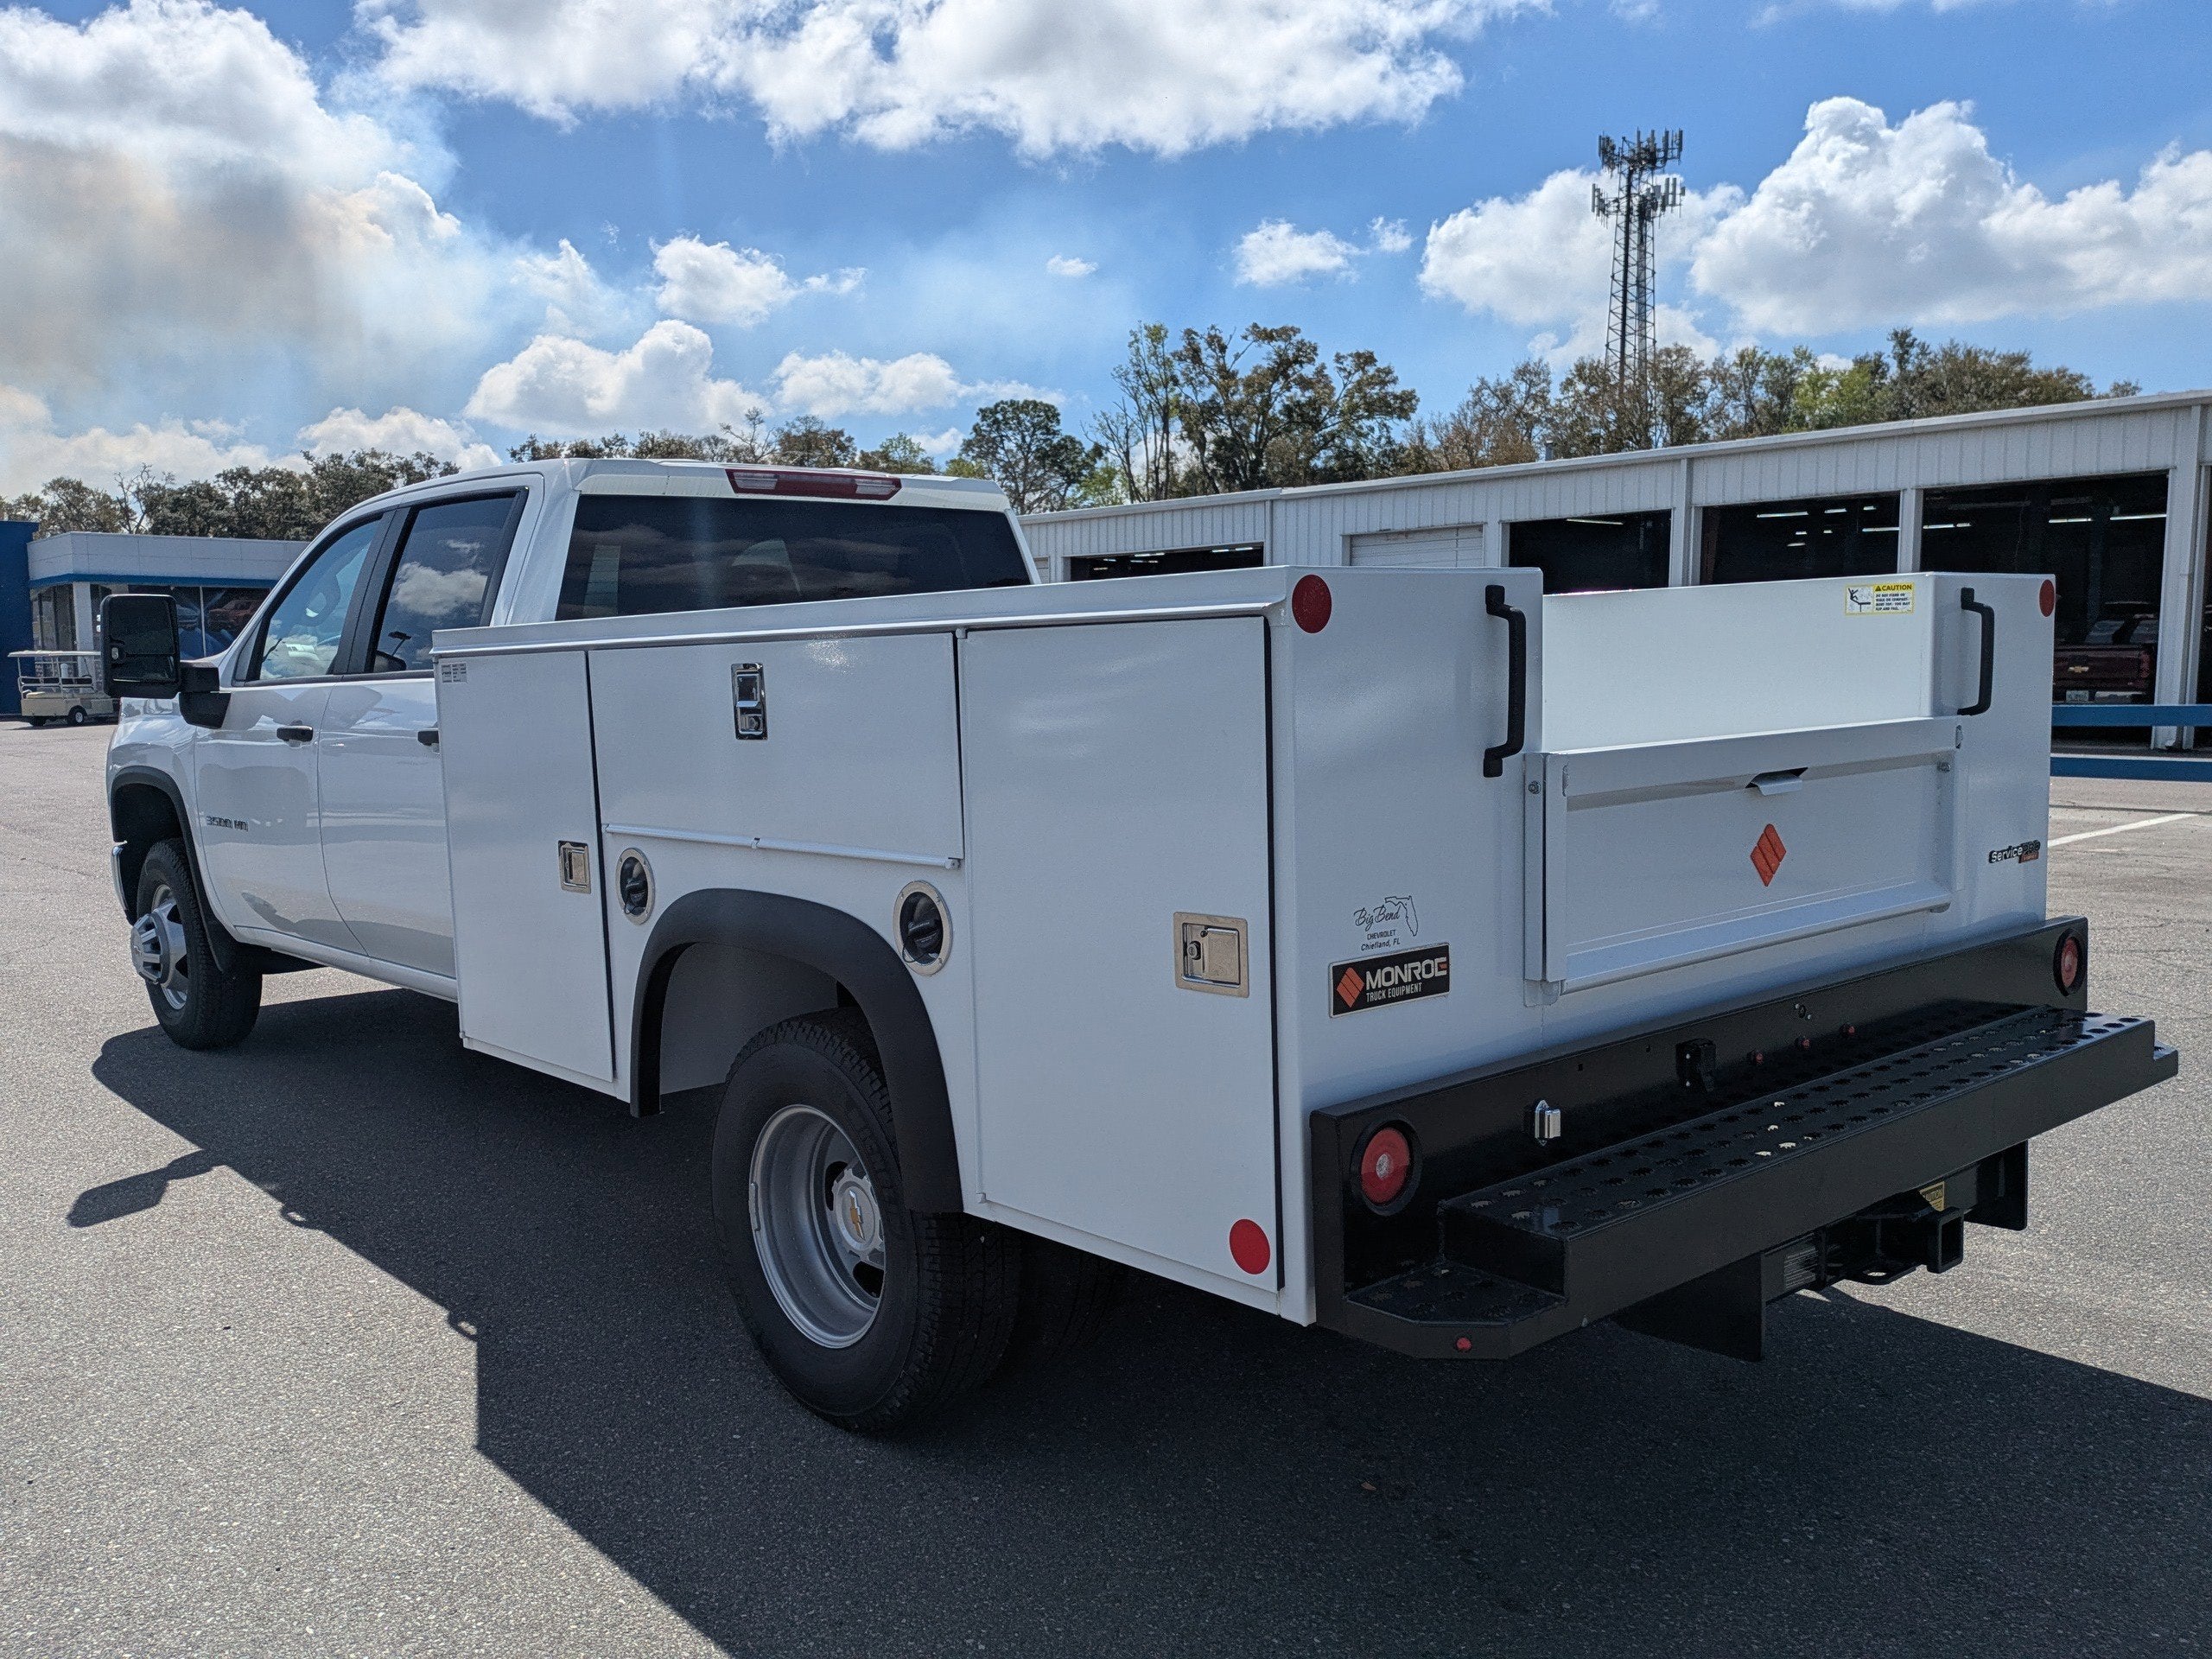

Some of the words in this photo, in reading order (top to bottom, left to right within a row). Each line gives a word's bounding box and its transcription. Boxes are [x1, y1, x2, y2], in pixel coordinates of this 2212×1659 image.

[207, 817, 233, 829] 3500
[1354, 907, 1375, 931] Big
[1374, 905, 1401, 923] Bend
[1367, 929, 1395, 940] CHEVROLET
[1361, 941, 1391, 950] Chiefland,
[1365, 957, 1447, 990] MONROE
[1366, 990, 1386, 1002] TRUCK
[1388, 982, 1423, 998] EQUIPMENT
